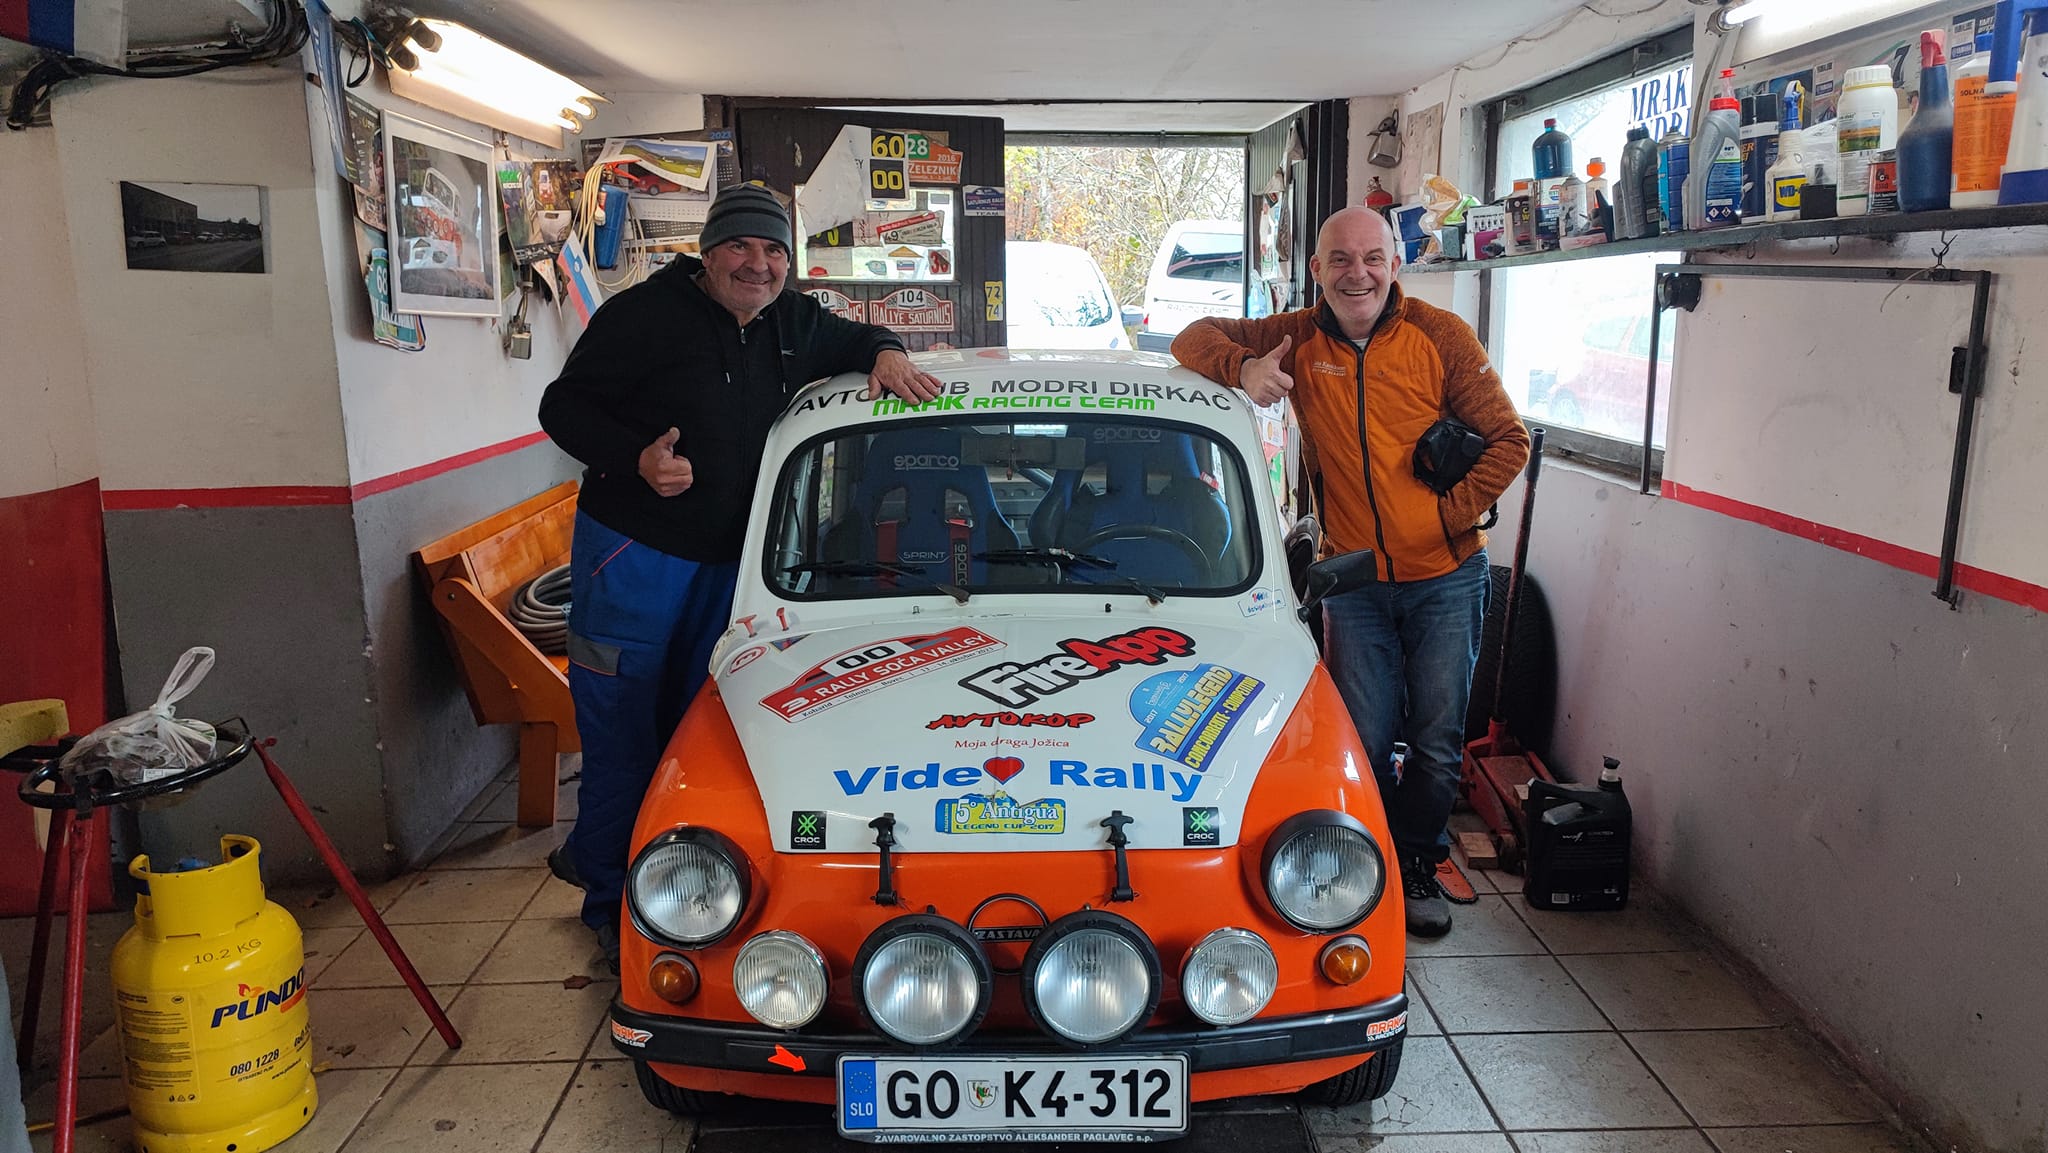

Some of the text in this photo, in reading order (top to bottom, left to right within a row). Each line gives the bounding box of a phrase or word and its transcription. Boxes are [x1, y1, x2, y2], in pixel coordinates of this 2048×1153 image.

[1628, 67, 1690, 124] MRAK
[871, 135, 905, 158] 60
[907, 138, 928, 156] 28
[872, 169, 903, 190] 00
[900, 290, 924, 303] 104
[986, 286, 1000, 299] 72
[873, 303, 951, 326] RALLYE SATURNUS
[987, 304, 999, 317] 74
[972, 396, 1072, 409] RACING
[991, 379, 1098, 394] MODRI
[1109, 381, 1232, 411] DIRKAČ
[1094, 427, 1162, 441] sparco
[894, 455, 959, 470] sparco
[903, 551, 946, 559] SPRINT
[815, 671, 870, 697] RALLY
[873, 653, 926, 676] SOČA
[923, 635, 987, 659] VALLEY
[836, 645, 896, 669] 00
[962, 627, 1193, 708] FireApp
[926, 711, 1096, 730] AVTOKOP
[954, 736, 1070, 750] Moja draga Jožica
[1050, 760, 1203, 802] Rally
[980, 801, 1059, 825] Antigua
[194, 938, 262, 964] 10.2 KG
[230, 1061, 252, 1077] 080
[256, 1048, 280, 1069] 1228
[886, 1069, 1171, 1119] GO K4-312
[850, 1102, 873, 1116] SLO
[874, 1132, 1153, 1143] ZAVAROVALNO ZASTOPSTVO ALEKSANDER PAGLAVEC s.p.
